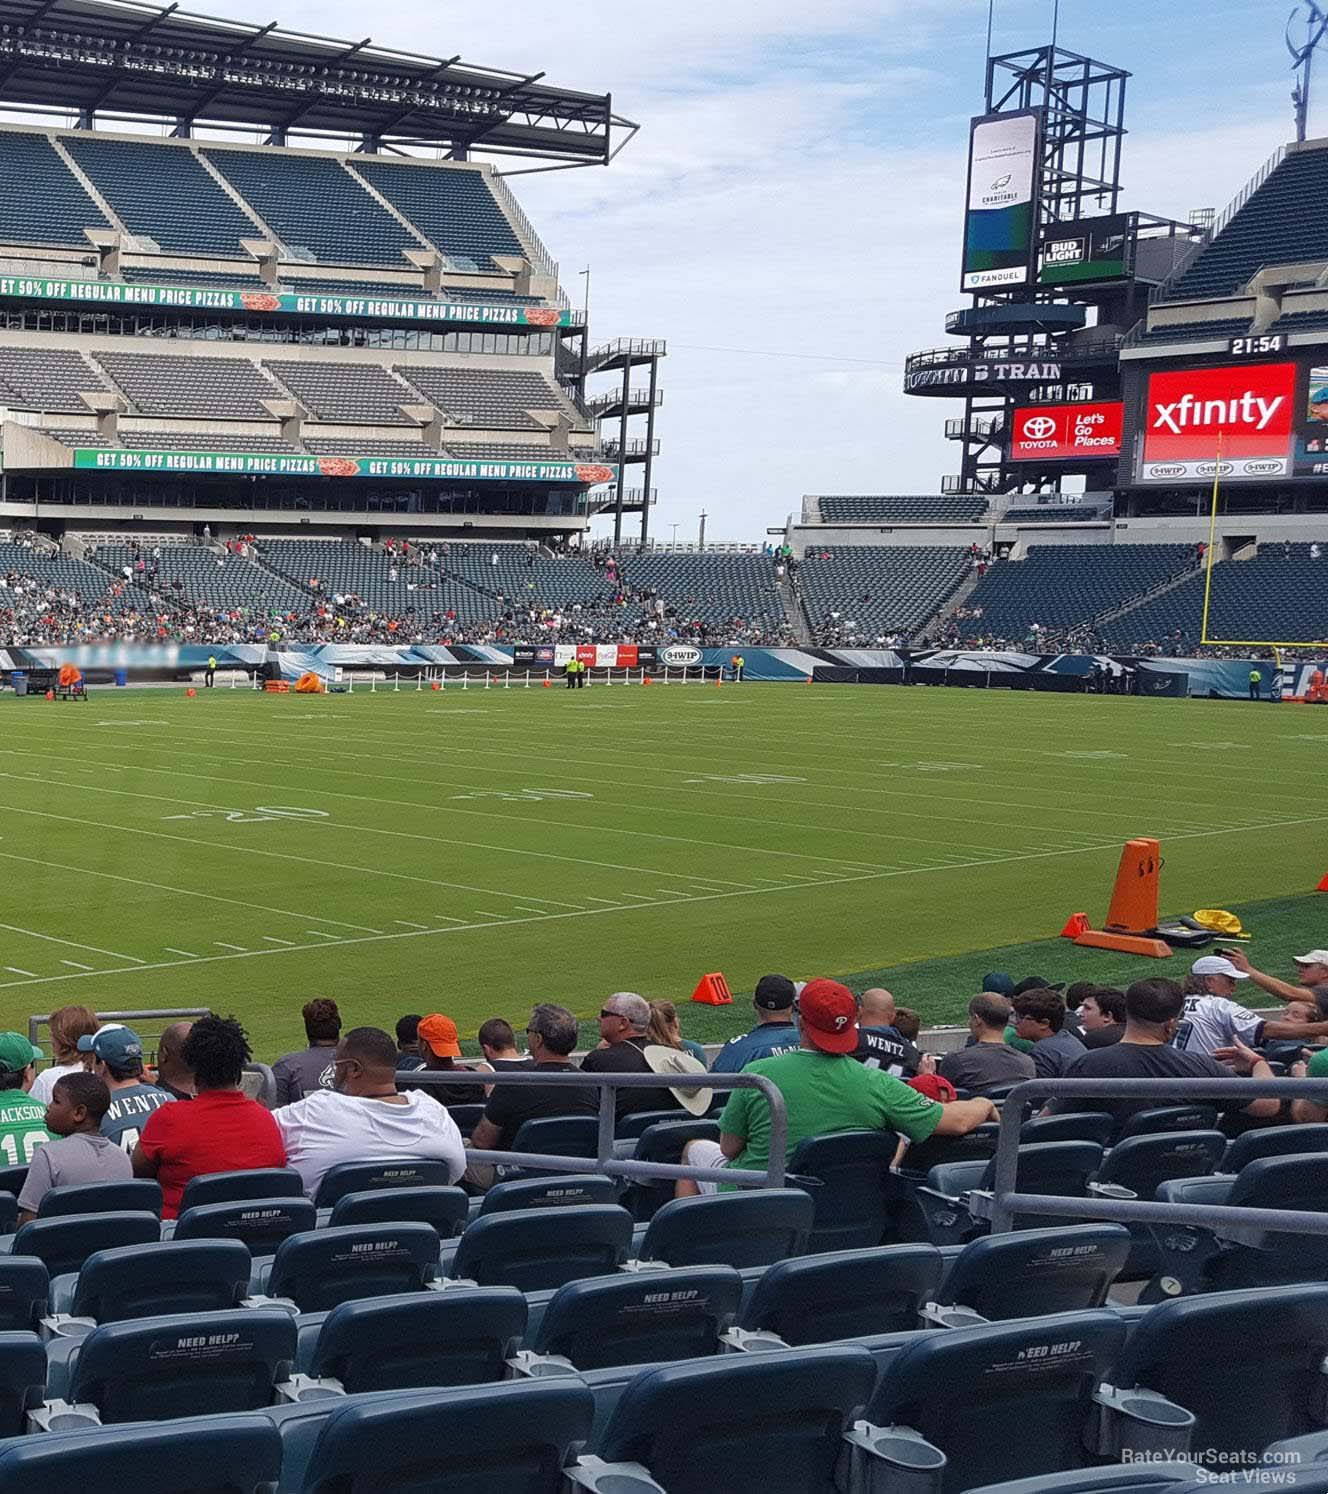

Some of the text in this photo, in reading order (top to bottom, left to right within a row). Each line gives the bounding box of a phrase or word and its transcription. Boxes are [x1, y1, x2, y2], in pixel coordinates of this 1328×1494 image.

[1050, 241, 1078, 253] BUD
[1045, 249, 1082, 262] LIGHT
[18, 280, 42, 296] 50%
[46, 281, 67, 297] OFF
[71, 283, 121, 301] REGULAR
[125, 287, 156, 303] MENU
[159, 288, 192, 305] PRICE
[195, 290, 234, 307] PIZZAS
[297, 297, 518, 322] GET 50% OFF REGULAR MENU PRICE PIZZAS
[1231, 335, 1281, 354] 21:54
[1153, 390, 1285, 434] xfinity
[1075, 413, 1104, 425] Let's
[1074, 426, 1093, 436] Go
[1019, 441, 1058, 449] TOYOTA
[1074, 437, 1116, 447] Places
[96, 453, 315, 473] GET 50% OFF REGULAR MENU PRICE PIZZAS
[369, 461, 572, 479] GET 50% OFF REGULAR MENU PRICE PIZZAS
[866, 1034, 904, 1057] WENTZ
[352, 1241, 398, 1252] NEED HELP?
[643, 1290, 699, 1303] NEED HELP?
[177, 1333, 240, 1349] NEED HELP?
[1050, 1340, 1081, 1353] HELP?
